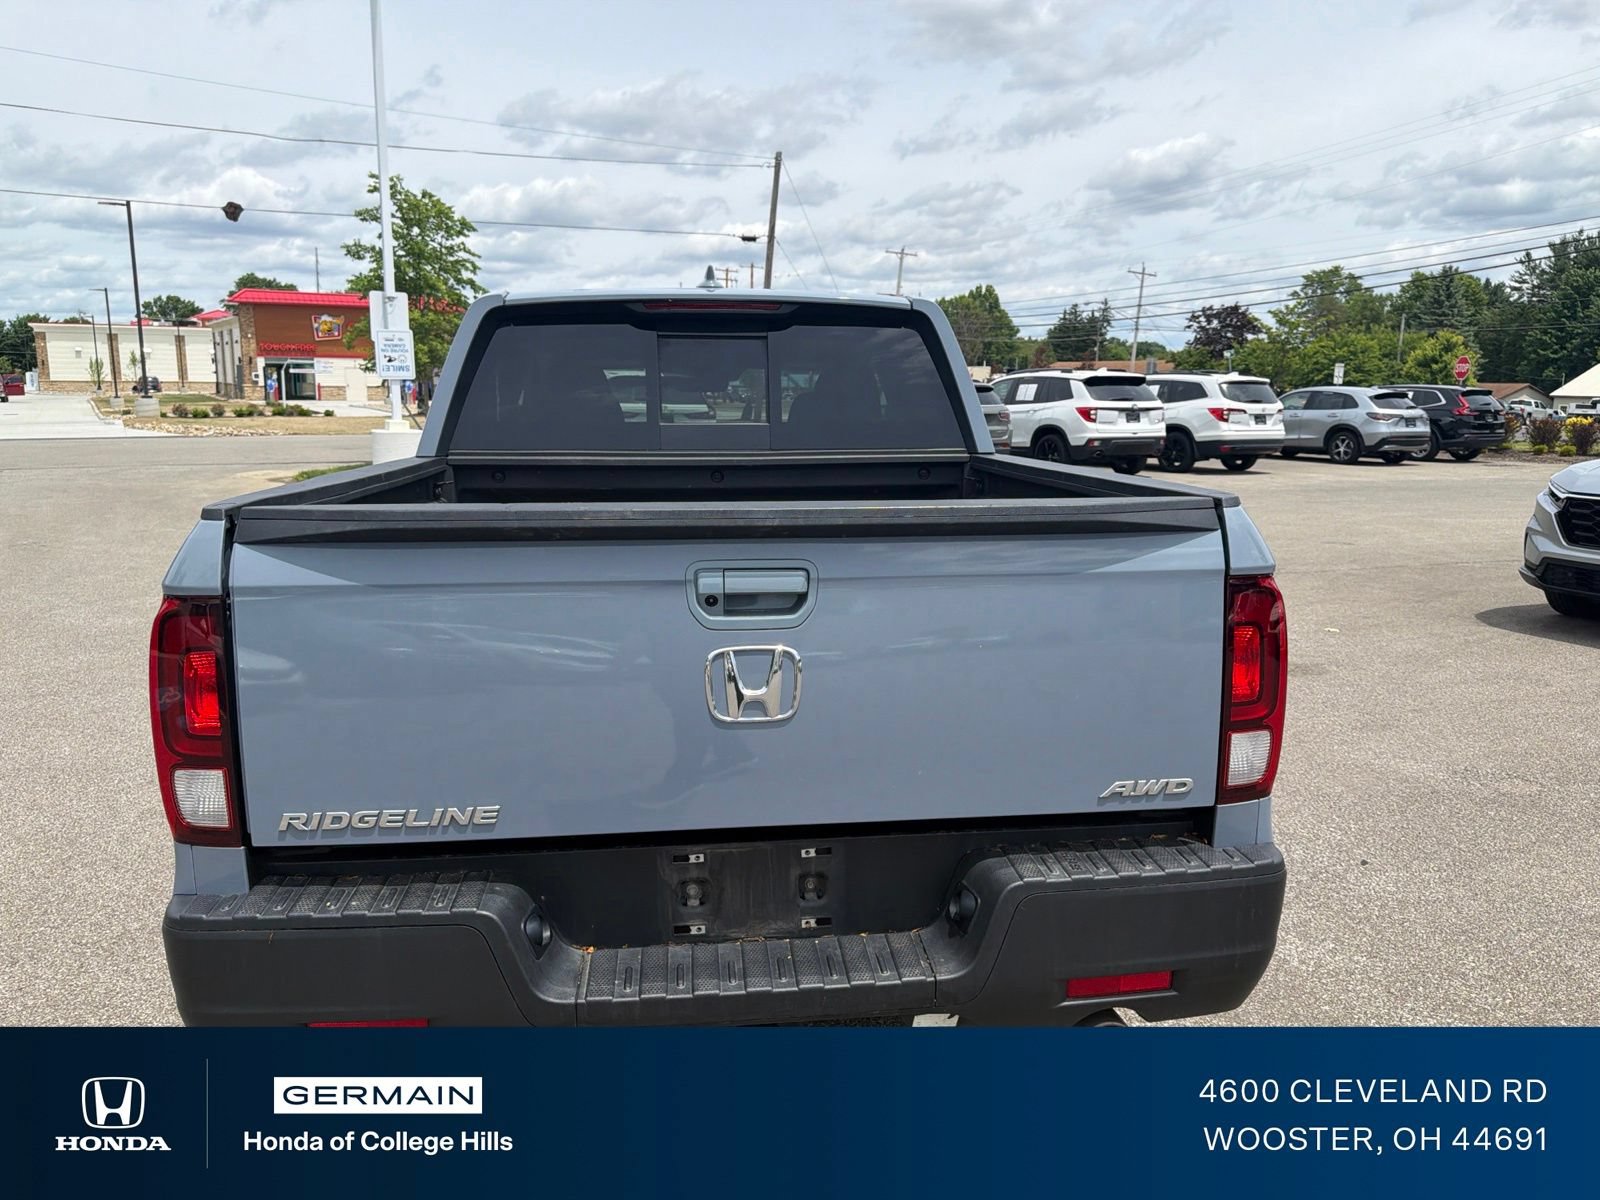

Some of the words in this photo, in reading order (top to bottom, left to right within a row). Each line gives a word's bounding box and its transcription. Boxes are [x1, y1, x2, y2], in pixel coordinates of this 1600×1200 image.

[382, 364, 410, 372] SMILE!
[1455, 363, 1470, 373] STOP
[1099, 778, 1194, 797] AWD
[278, 805, 501, 832] RIDGELINE
